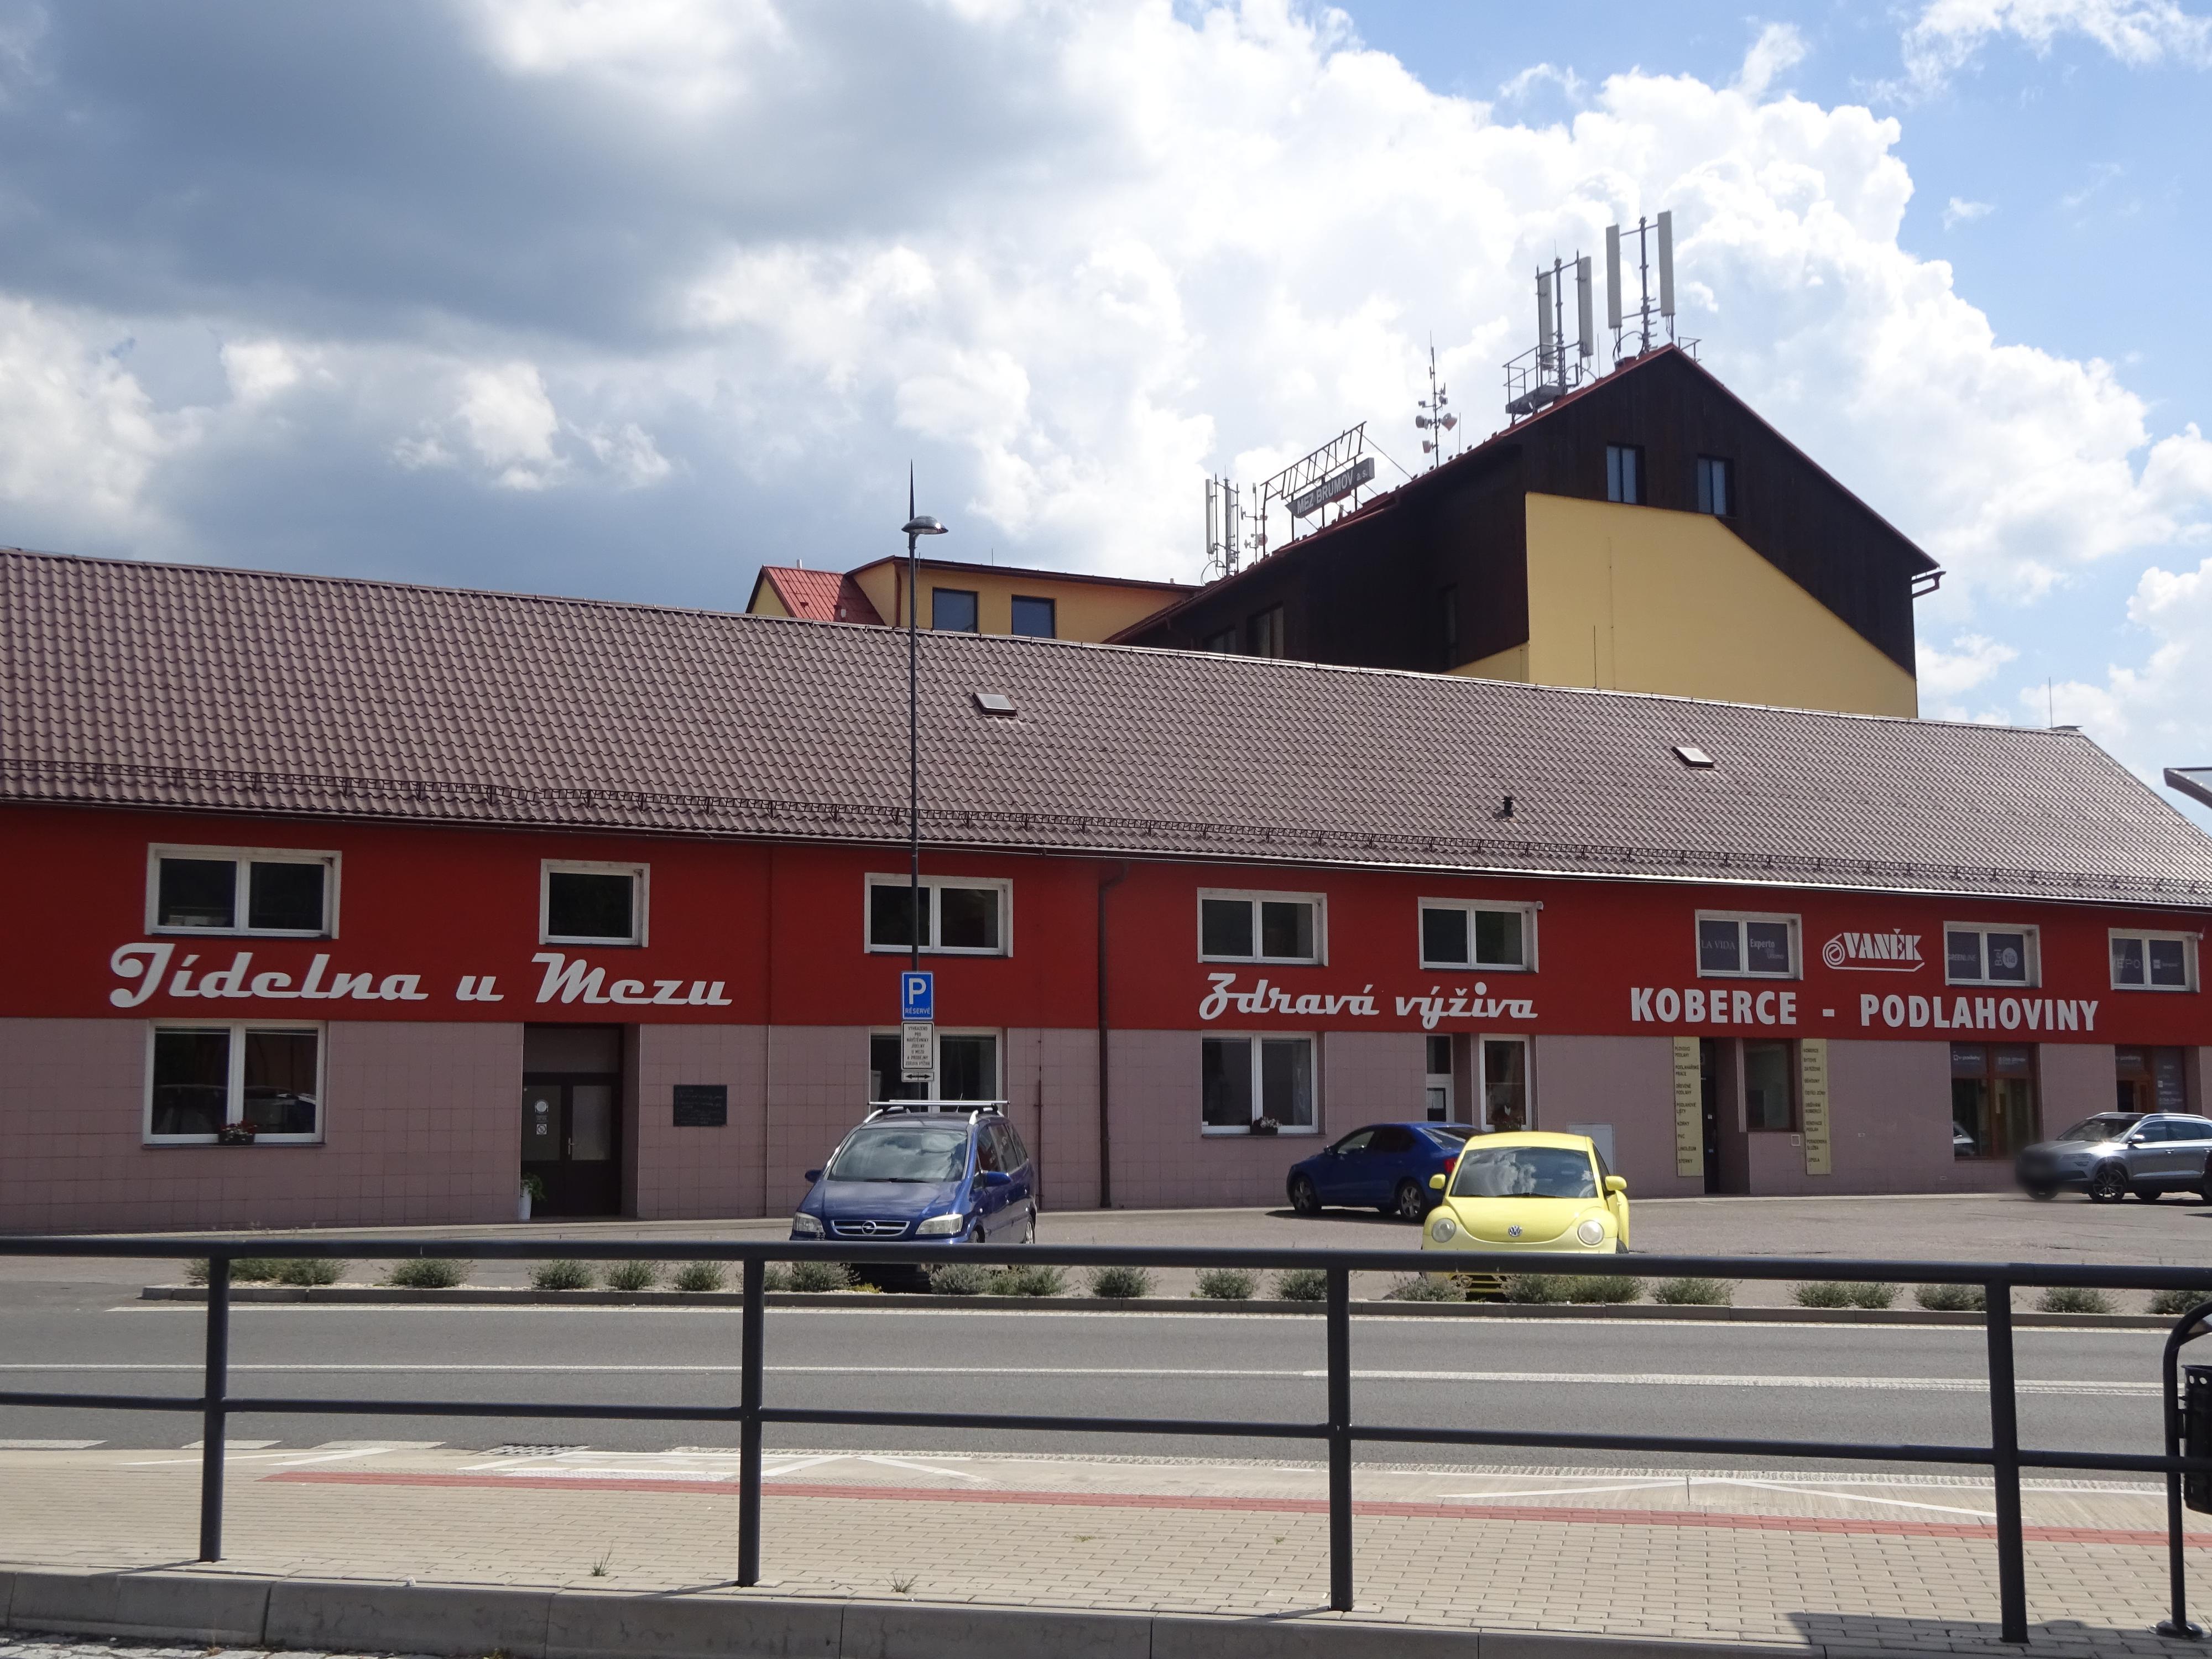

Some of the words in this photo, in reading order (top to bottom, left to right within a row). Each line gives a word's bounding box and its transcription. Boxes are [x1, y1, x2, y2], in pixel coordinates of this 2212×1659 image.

[1297, 493, 1314, 514] MEZ
[1316, 470, 1353, 504] BRUMOV
[1750, 938, 1775, 950] Experto
[110, 943, 429, 1008] Jídelna
[456, 976, 504, 1001] u
[532, 952, 732, 1005] Mezu
[909, 978, 926, 1005] P
[1199, 973, 1379, 1020] Zdravá
[1396, 982, 1538, 1030] výživa
[1628, 987, 1797, 1025] KOBERCE
[1861, 994, 2098, 1031] PODLAHOVINY
